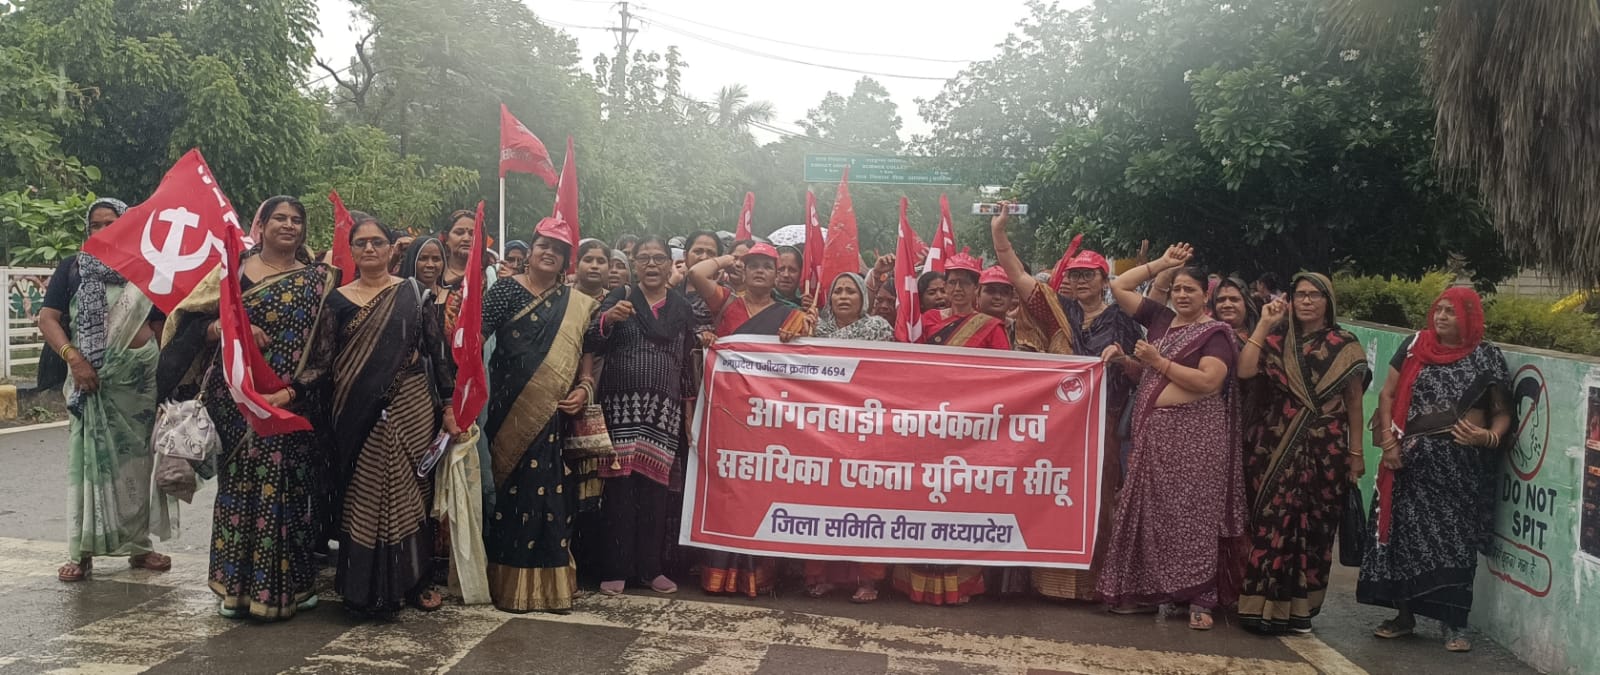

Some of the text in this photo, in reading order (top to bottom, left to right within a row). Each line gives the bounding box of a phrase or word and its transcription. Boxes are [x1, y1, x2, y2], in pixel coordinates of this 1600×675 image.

[821, 366, 846, 377] 4694
[747, 391, 1050, 442] आंगनबाड़ी कार्यकर्ता एवं
[716, 445, 1073, 506] सहायिका एकता यूनियन सीटू
[1503, 473, 1557, 517] DO NOT
[771, 508, 1014, 544] जिला समिति रीवा मध्यप्रदेश
[1512, 510, 1547, 550] SPIT
